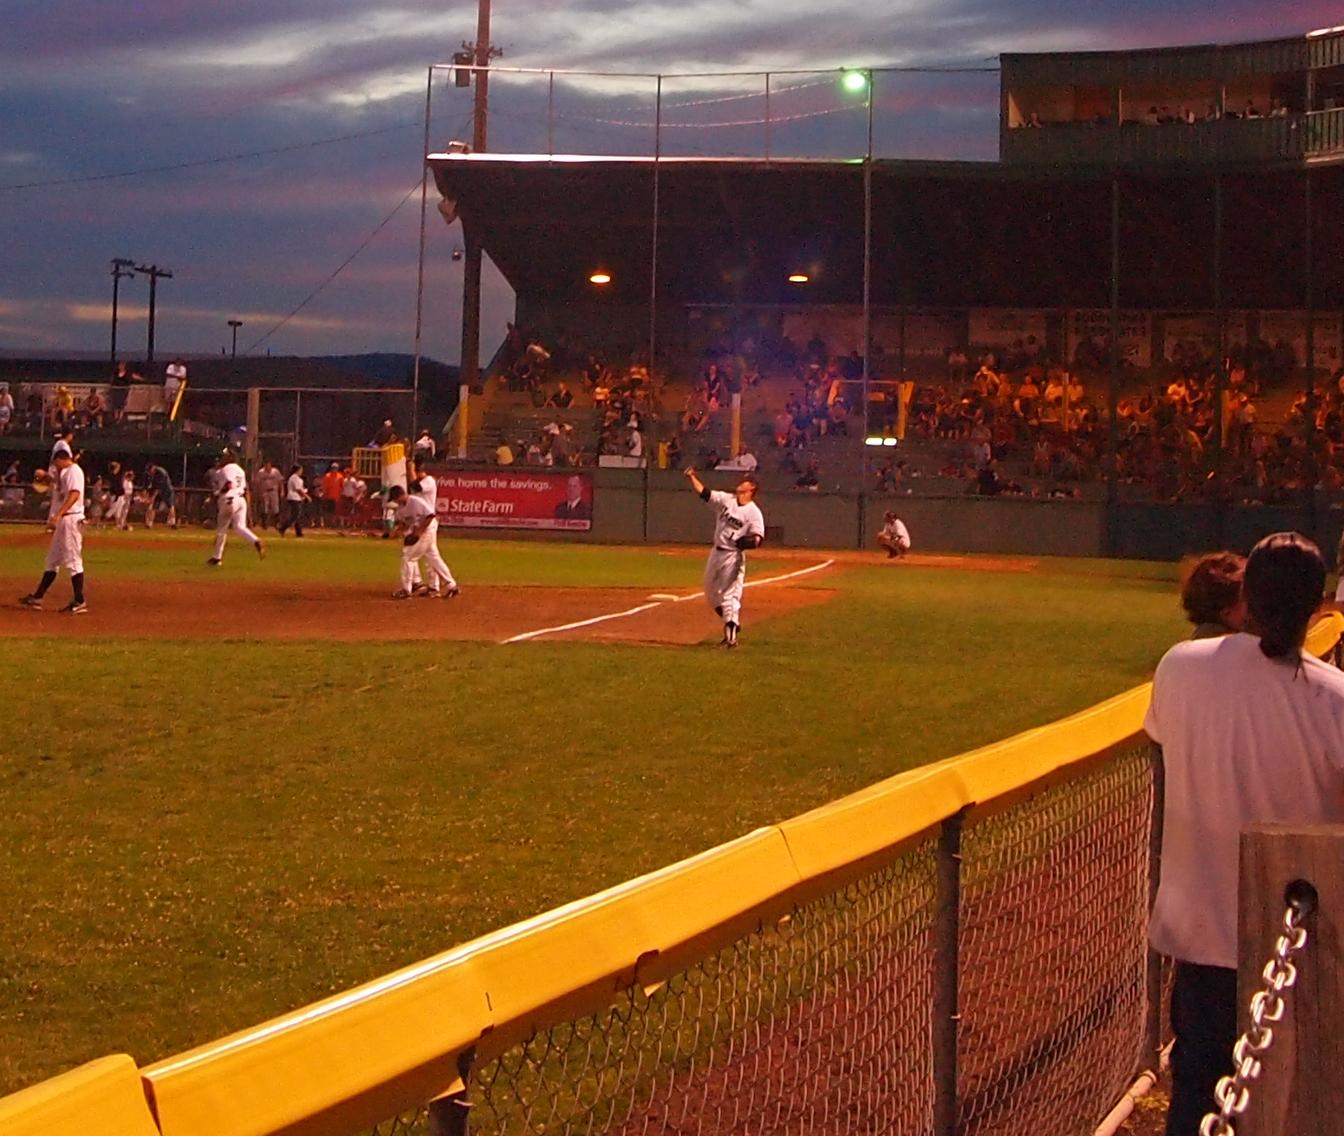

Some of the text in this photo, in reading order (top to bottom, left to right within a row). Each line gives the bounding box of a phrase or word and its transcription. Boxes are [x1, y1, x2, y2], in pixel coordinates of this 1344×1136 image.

[457, 476, 487, 489] home
[490, 477, 507, 490] the
[510, 479, 552, 492] savings.
